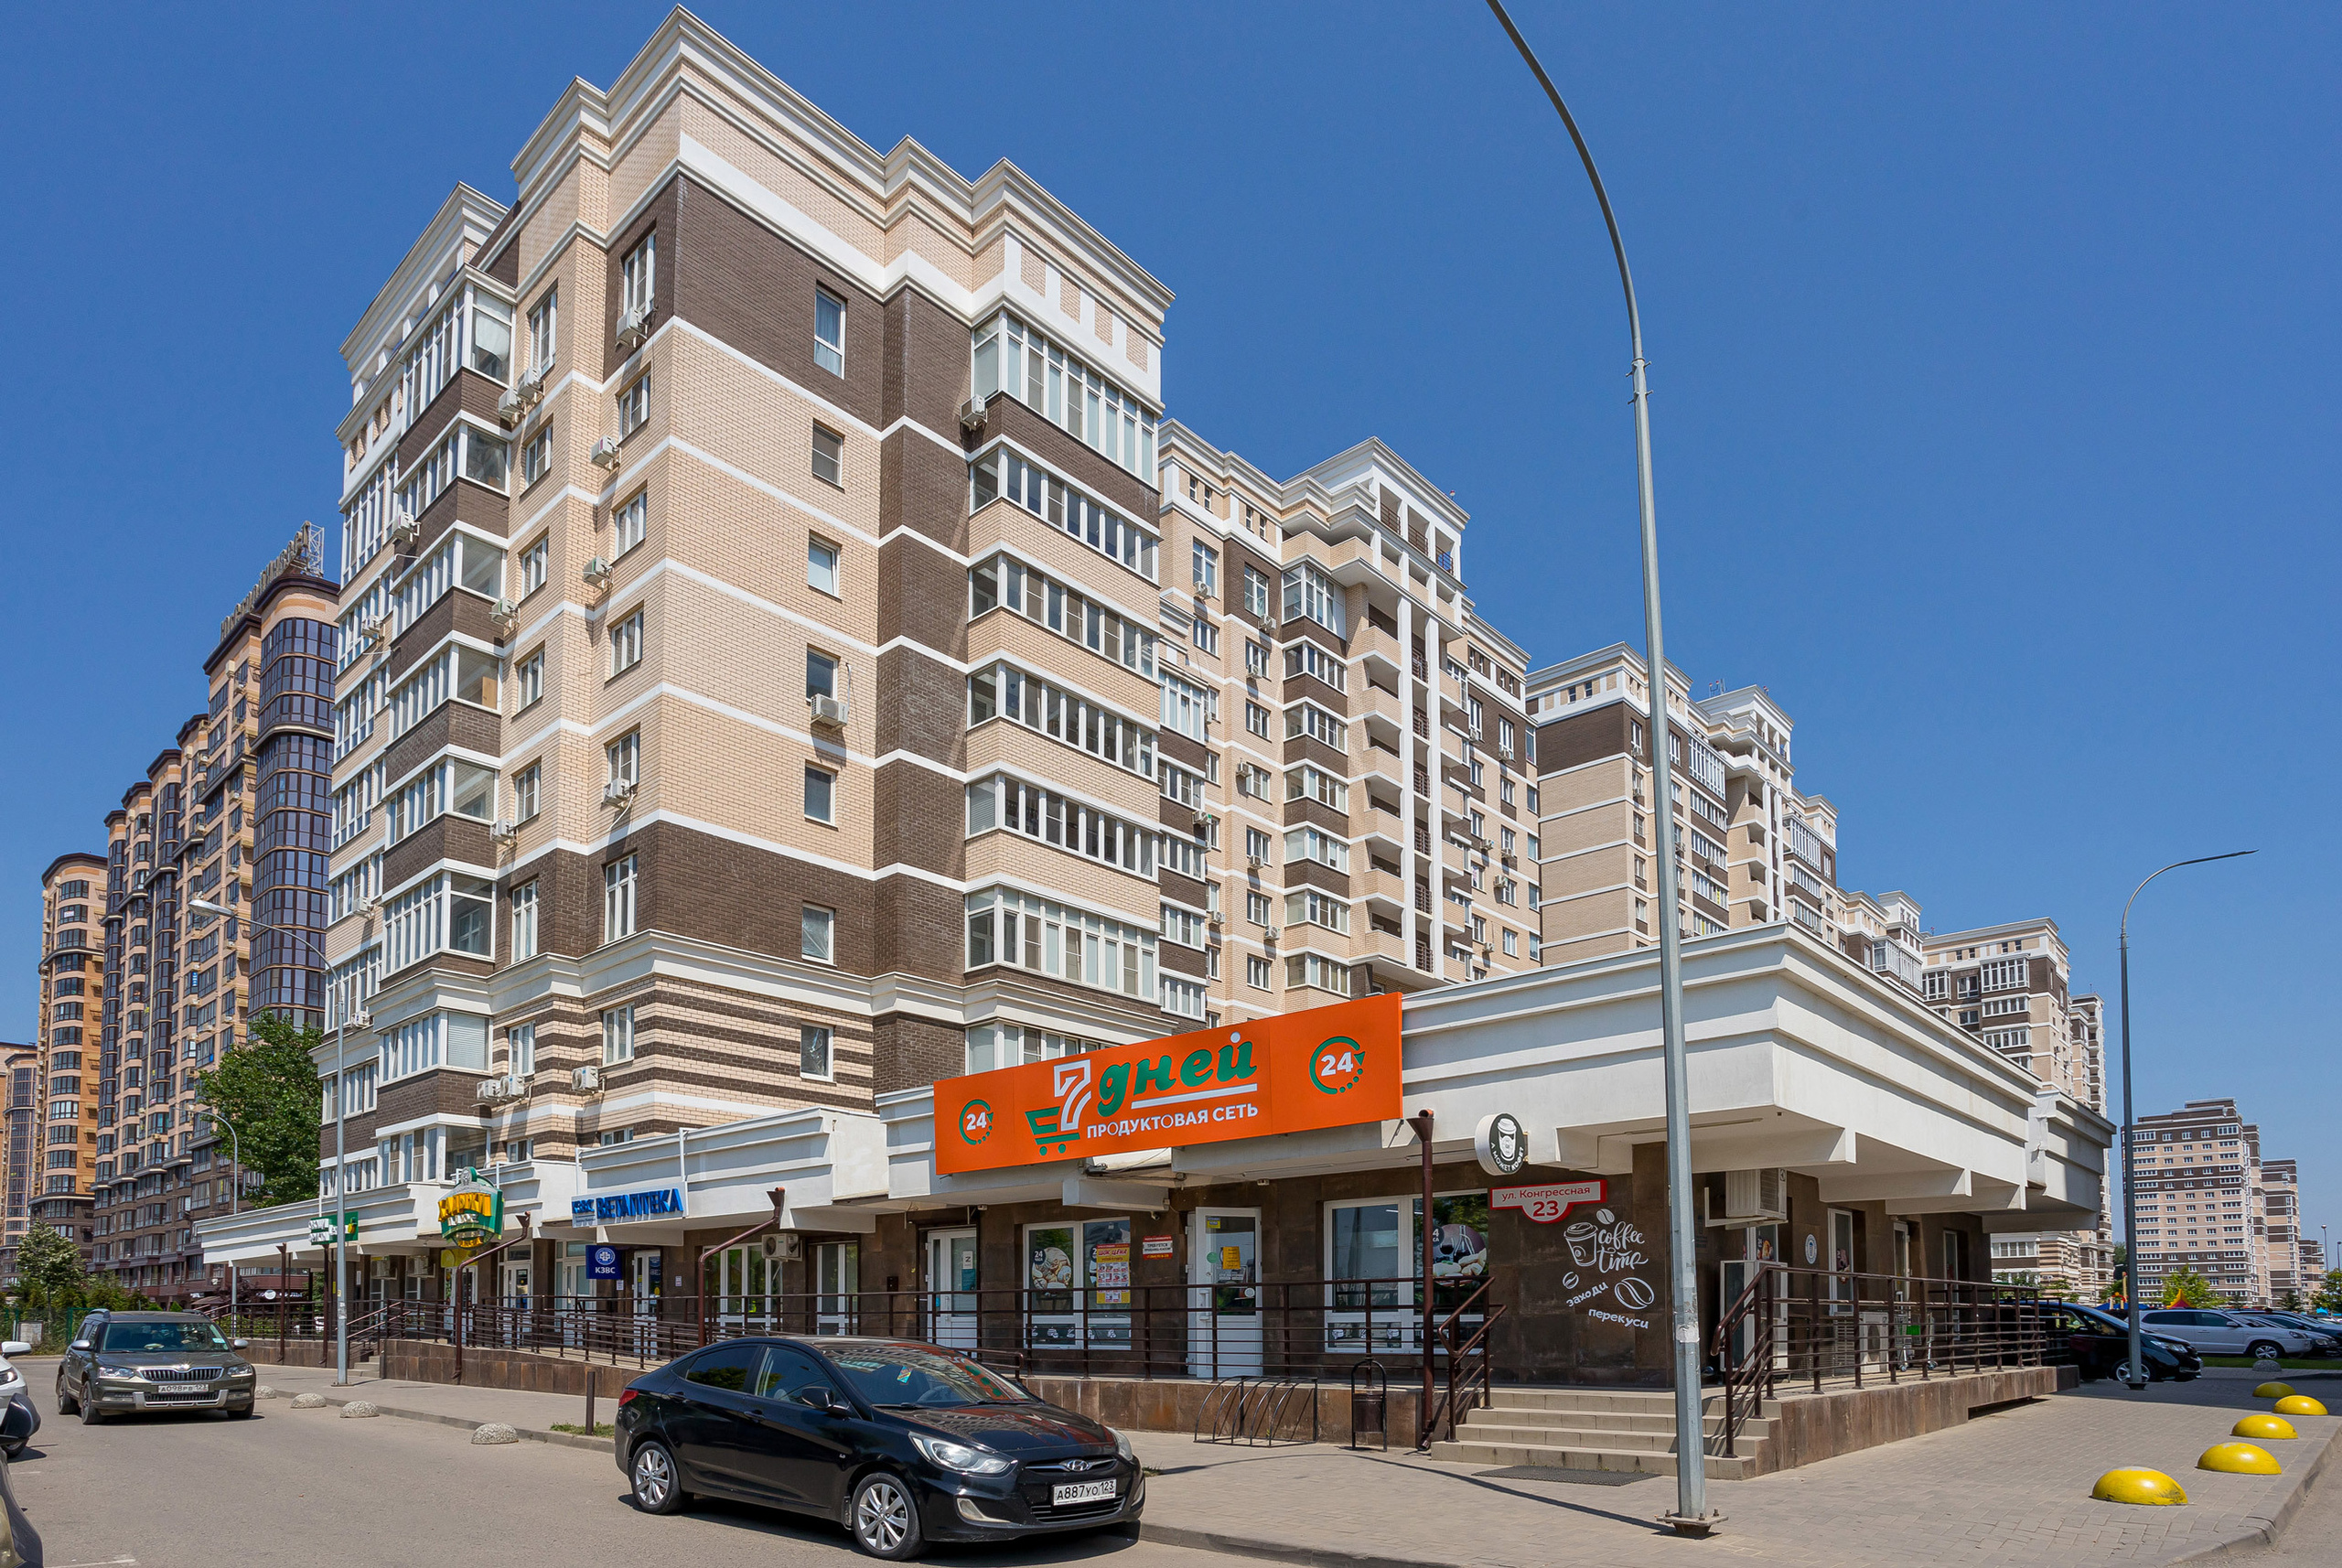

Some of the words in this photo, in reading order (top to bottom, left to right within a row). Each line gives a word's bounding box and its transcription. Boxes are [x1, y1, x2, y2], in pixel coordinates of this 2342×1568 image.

[1320, 1051, 1355, 1077] 24
[1054, 1058, 1091, 1132] 7
[1098, 1031, 1258, 1118] дней
[966, 1112, 988, 1132] 24
[1087, 1109, 1209, 1139] ПРОДУКТОВАЯ
[1212, 1102, 1259, 1122] СЕТЬ
[1492, 1150, 1511, 1172] МОЖЕТ
[596, 1187, 684, 1219] ВЕТАПТЕКА
[1501, 1192, 1517, 1202] ул.
[1520, 1187, 1591, 1199] Конгрессная
[1532, 1200, 1559, 1218] 23
[1597, 1221, 1646, 1251] coffee
[1596, 1245, 1649, 1273] time
[1565, 1282, 1609, 1307] заходи
[1588, 1308, 1649, 1329] перекуси
[1100, 1480, 1114, 1492] 123
